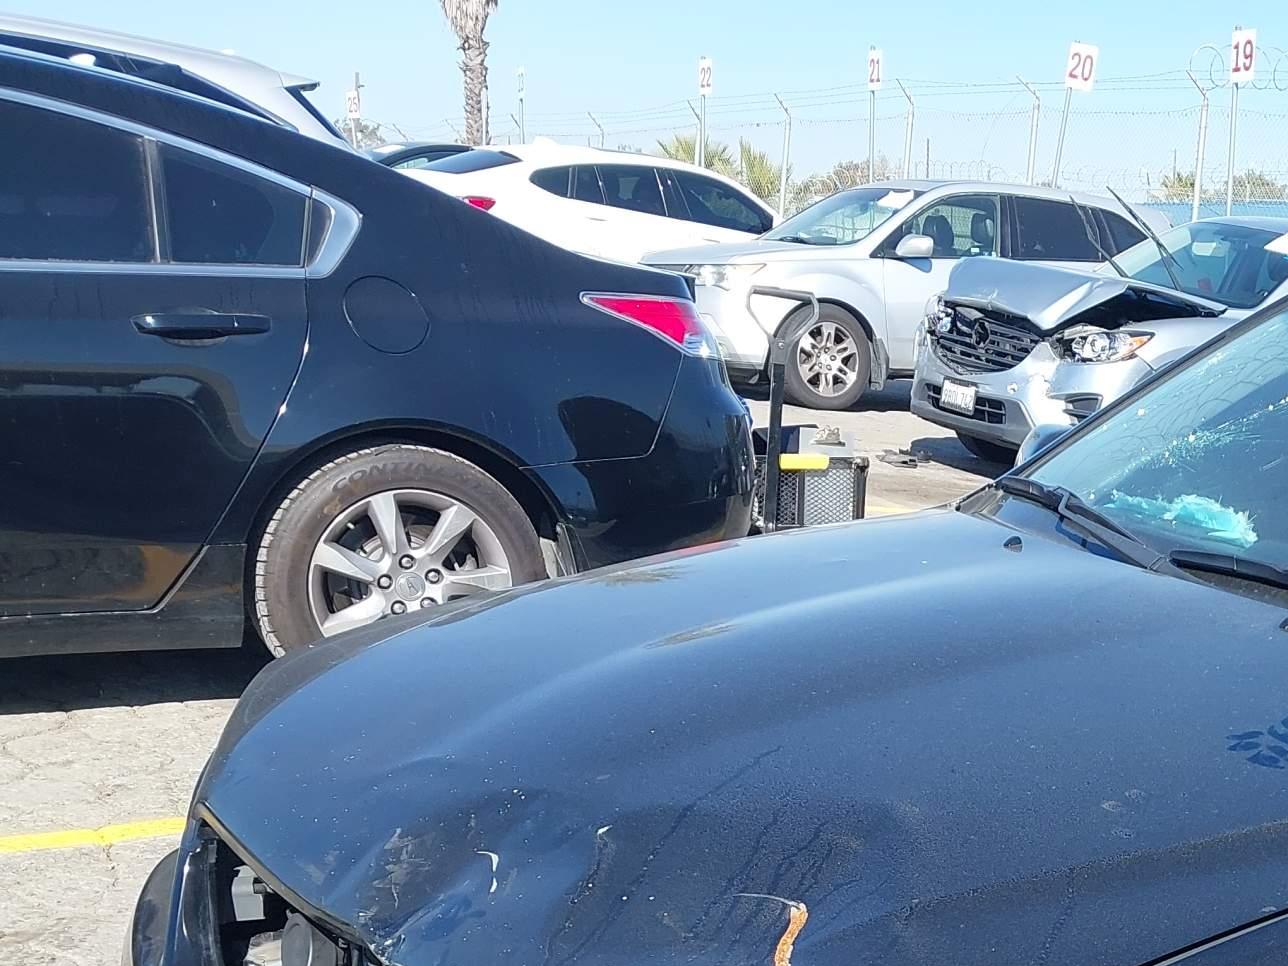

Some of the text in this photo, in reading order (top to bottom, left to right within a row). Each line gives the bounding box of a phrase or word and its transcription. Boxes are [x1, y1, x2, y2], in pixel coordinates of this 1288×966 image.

[1068, 51, 1094, 81] 20
[1231, 39, 1254, 73] 19
[699, 66, 712, 88] 22
[868, 58, 881, 83] 21
